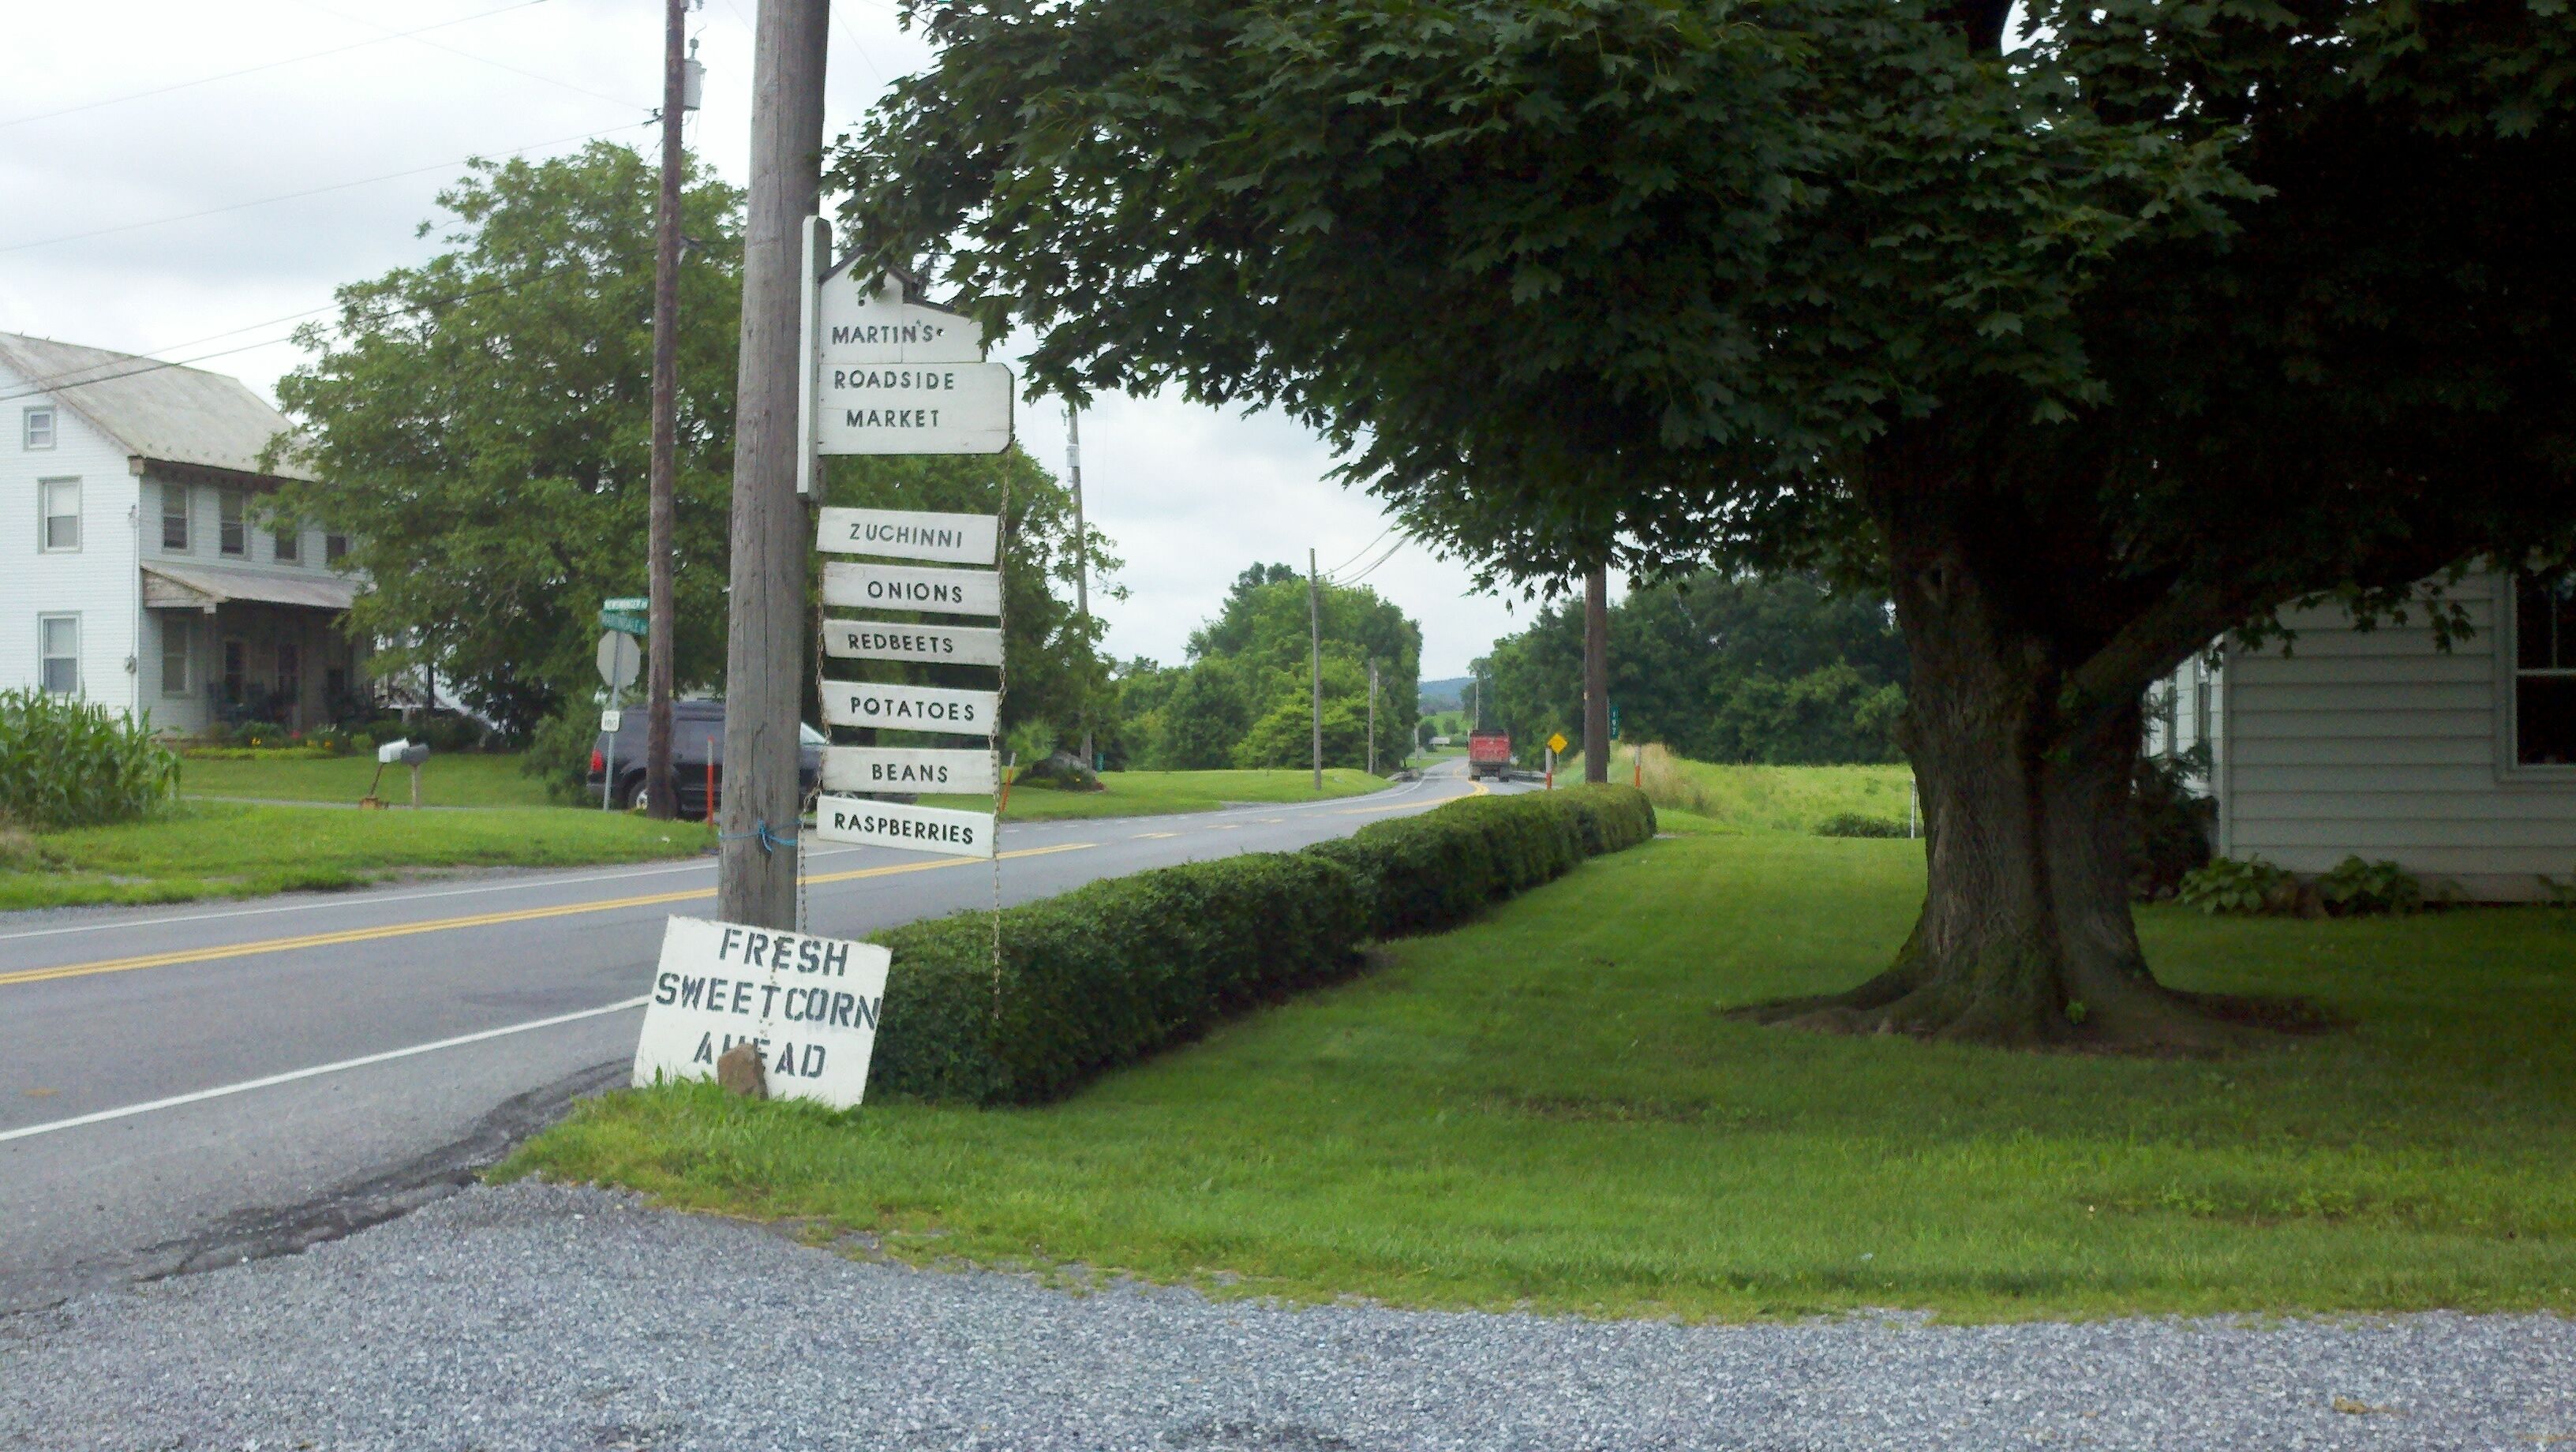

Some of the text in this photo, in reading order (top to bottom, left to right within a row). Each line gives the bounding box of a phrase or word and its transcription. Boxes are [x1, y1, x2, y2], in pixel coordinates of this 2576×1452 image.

[832, 320, 934, 345] MARTIN'S
[834, 369, 954, 391] ROADSIDE
[846, 409, 939, 428] MARKET
[849, 523, 962, 548] ZUCHINNI
[867, 581, 962, 604] ONIONS
[848, 634, 953, 653] REDBEETS
[850, 696, 974, 721] POTATOES
[872, 763, 948, 783] BEANS
[834, 813, 973, 844] RASPBERRIES
[719, 927, 849, 977] FRESH
[655, 972, 881, 1031] SWEETCORN
